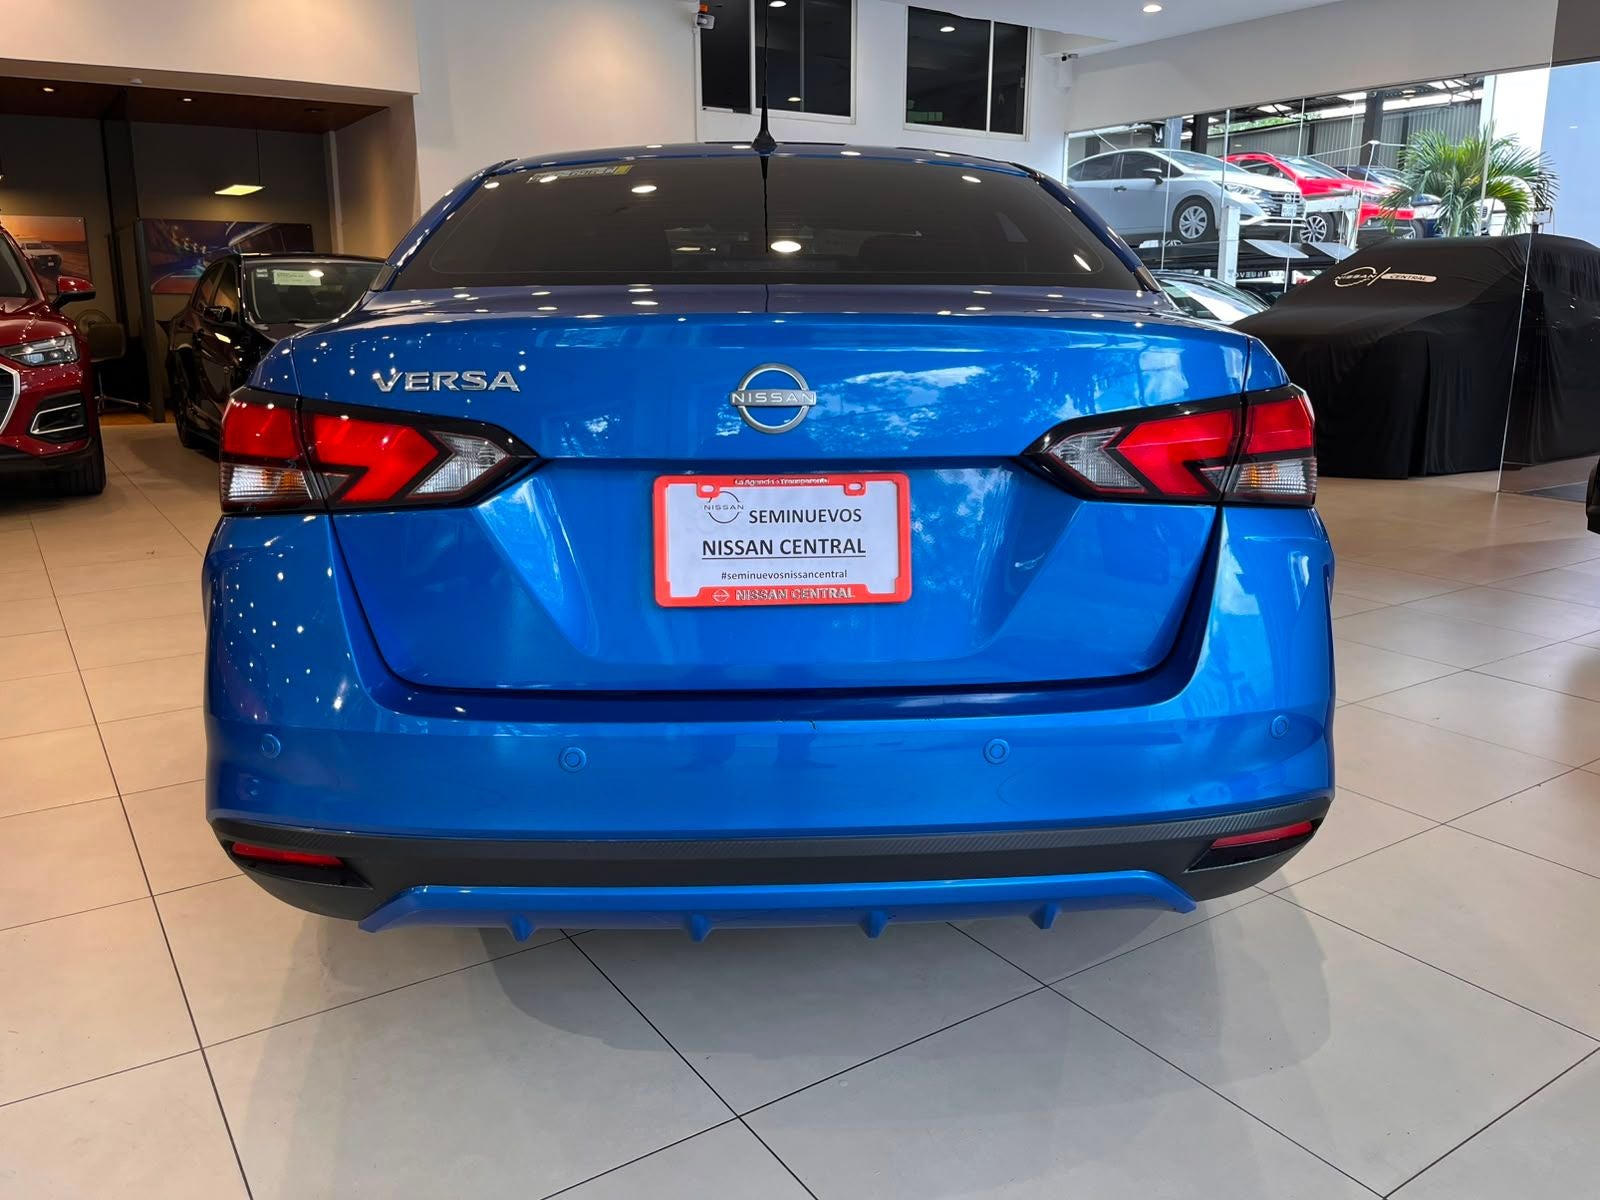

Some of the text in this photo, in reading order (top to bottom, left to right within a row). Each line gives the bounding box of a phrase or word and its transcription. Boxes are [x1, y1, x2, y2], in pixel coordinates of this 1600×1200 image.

[1334, 272, 1427, 282] NISSAN CENTRAL
[372, 370, 521, 393] VERSA
[731, 392, 815, 404] NISSAN
[749, 508, 862, 524] SEMINUEVOS
[702, 538, 866, 556] NISSAN CENTRAL
[721, 569, 848, 580] #seminuevosnissancentral
[735, 587, 855, 601] NISSAN CENTRAL
